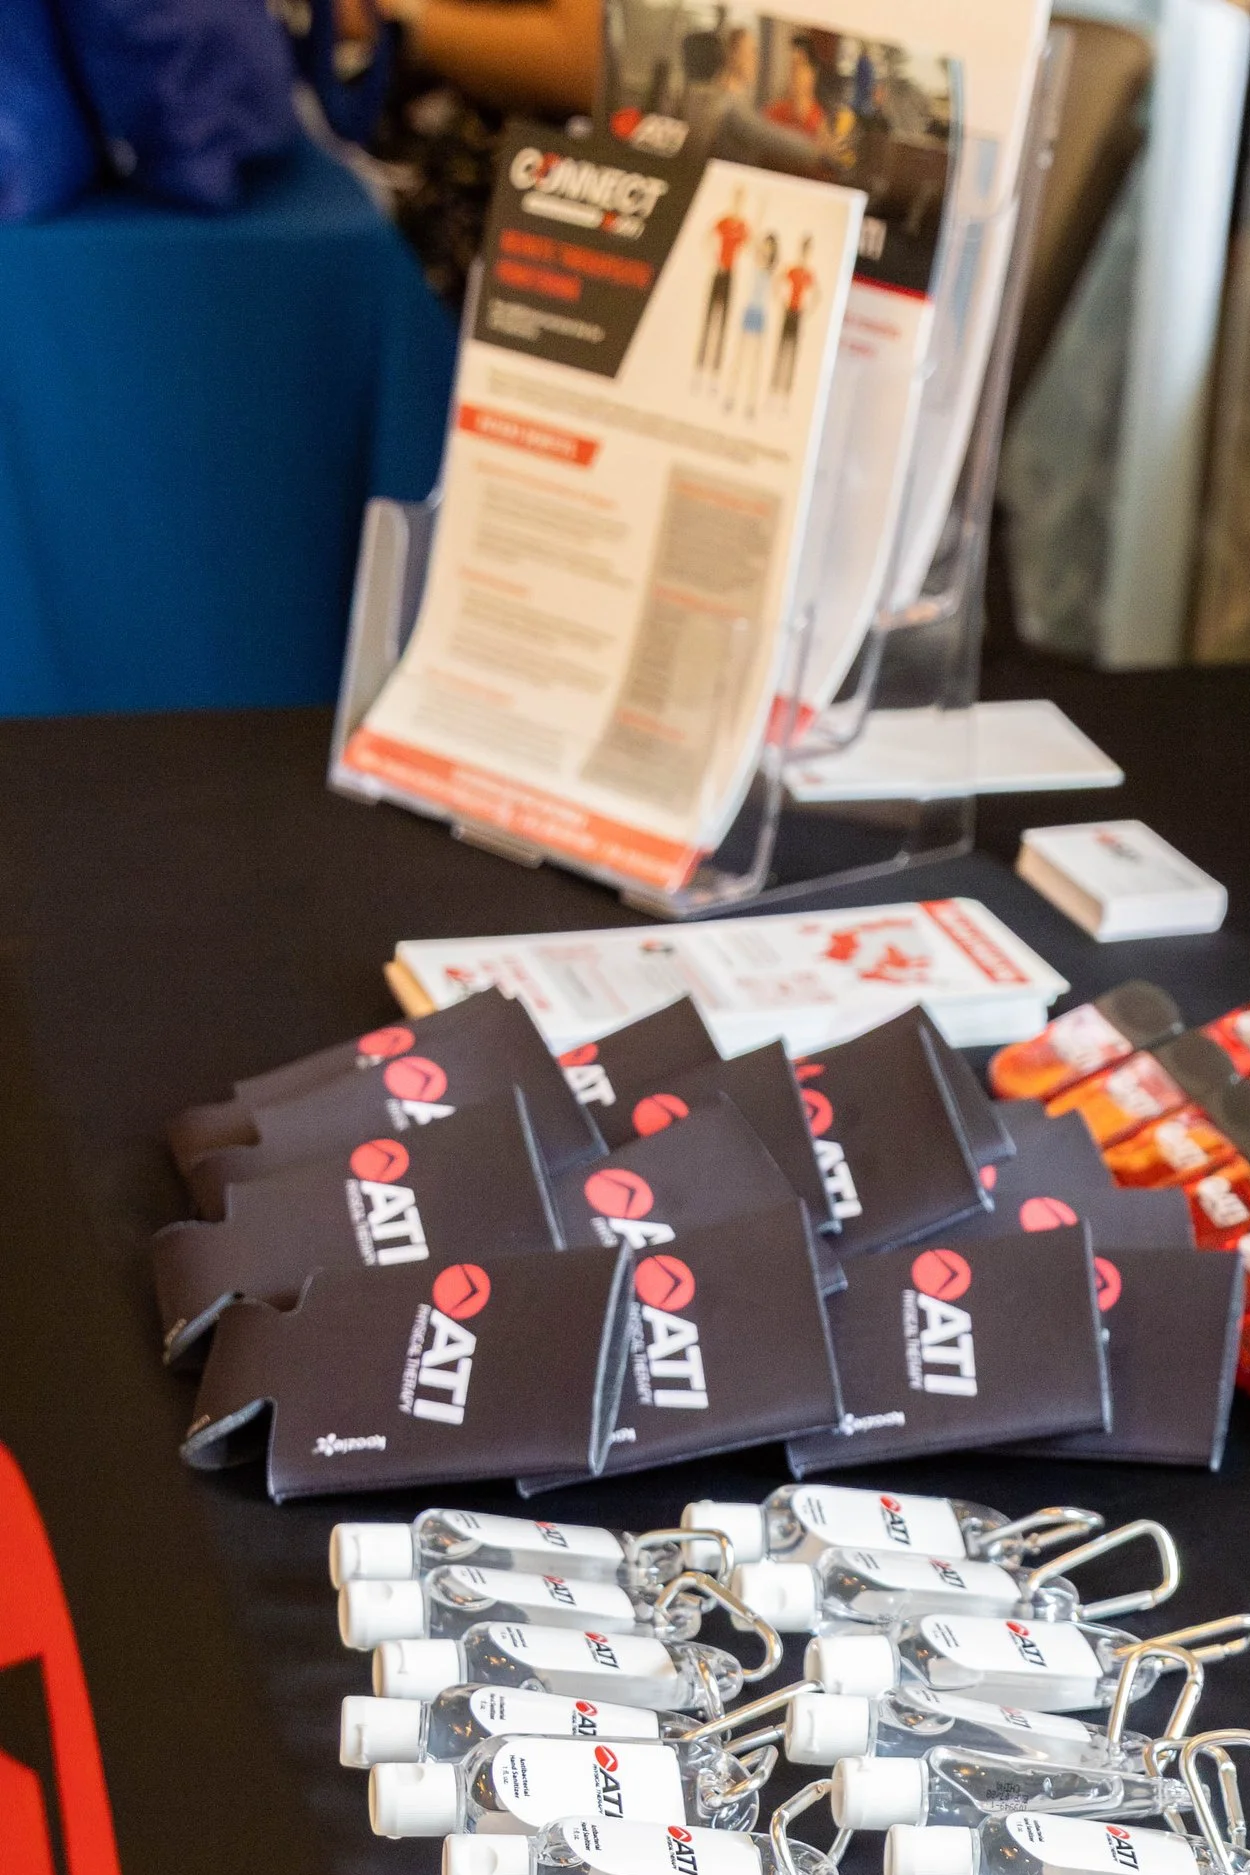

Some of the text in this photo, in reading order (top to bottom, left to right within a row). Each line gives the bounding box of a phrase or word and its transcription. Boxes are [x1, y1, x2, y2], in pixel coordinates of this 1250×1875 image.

[362, 1179, 430, 1266] ATI
[413, 1311, 477, 1425] ATI
[641, 1304, 708, 1409] ATI
[914, 1293, 978, 1397] ATI
[591, 1641, 620, 1670] ATI
[509, 1754, 521, 1799] Hand Sanitizer
[519, 1757, 531, 1798] Antibacterial
[599, 1770, 624, 1819] ATI
[1113, 1835, 1140, 1872] ATI
